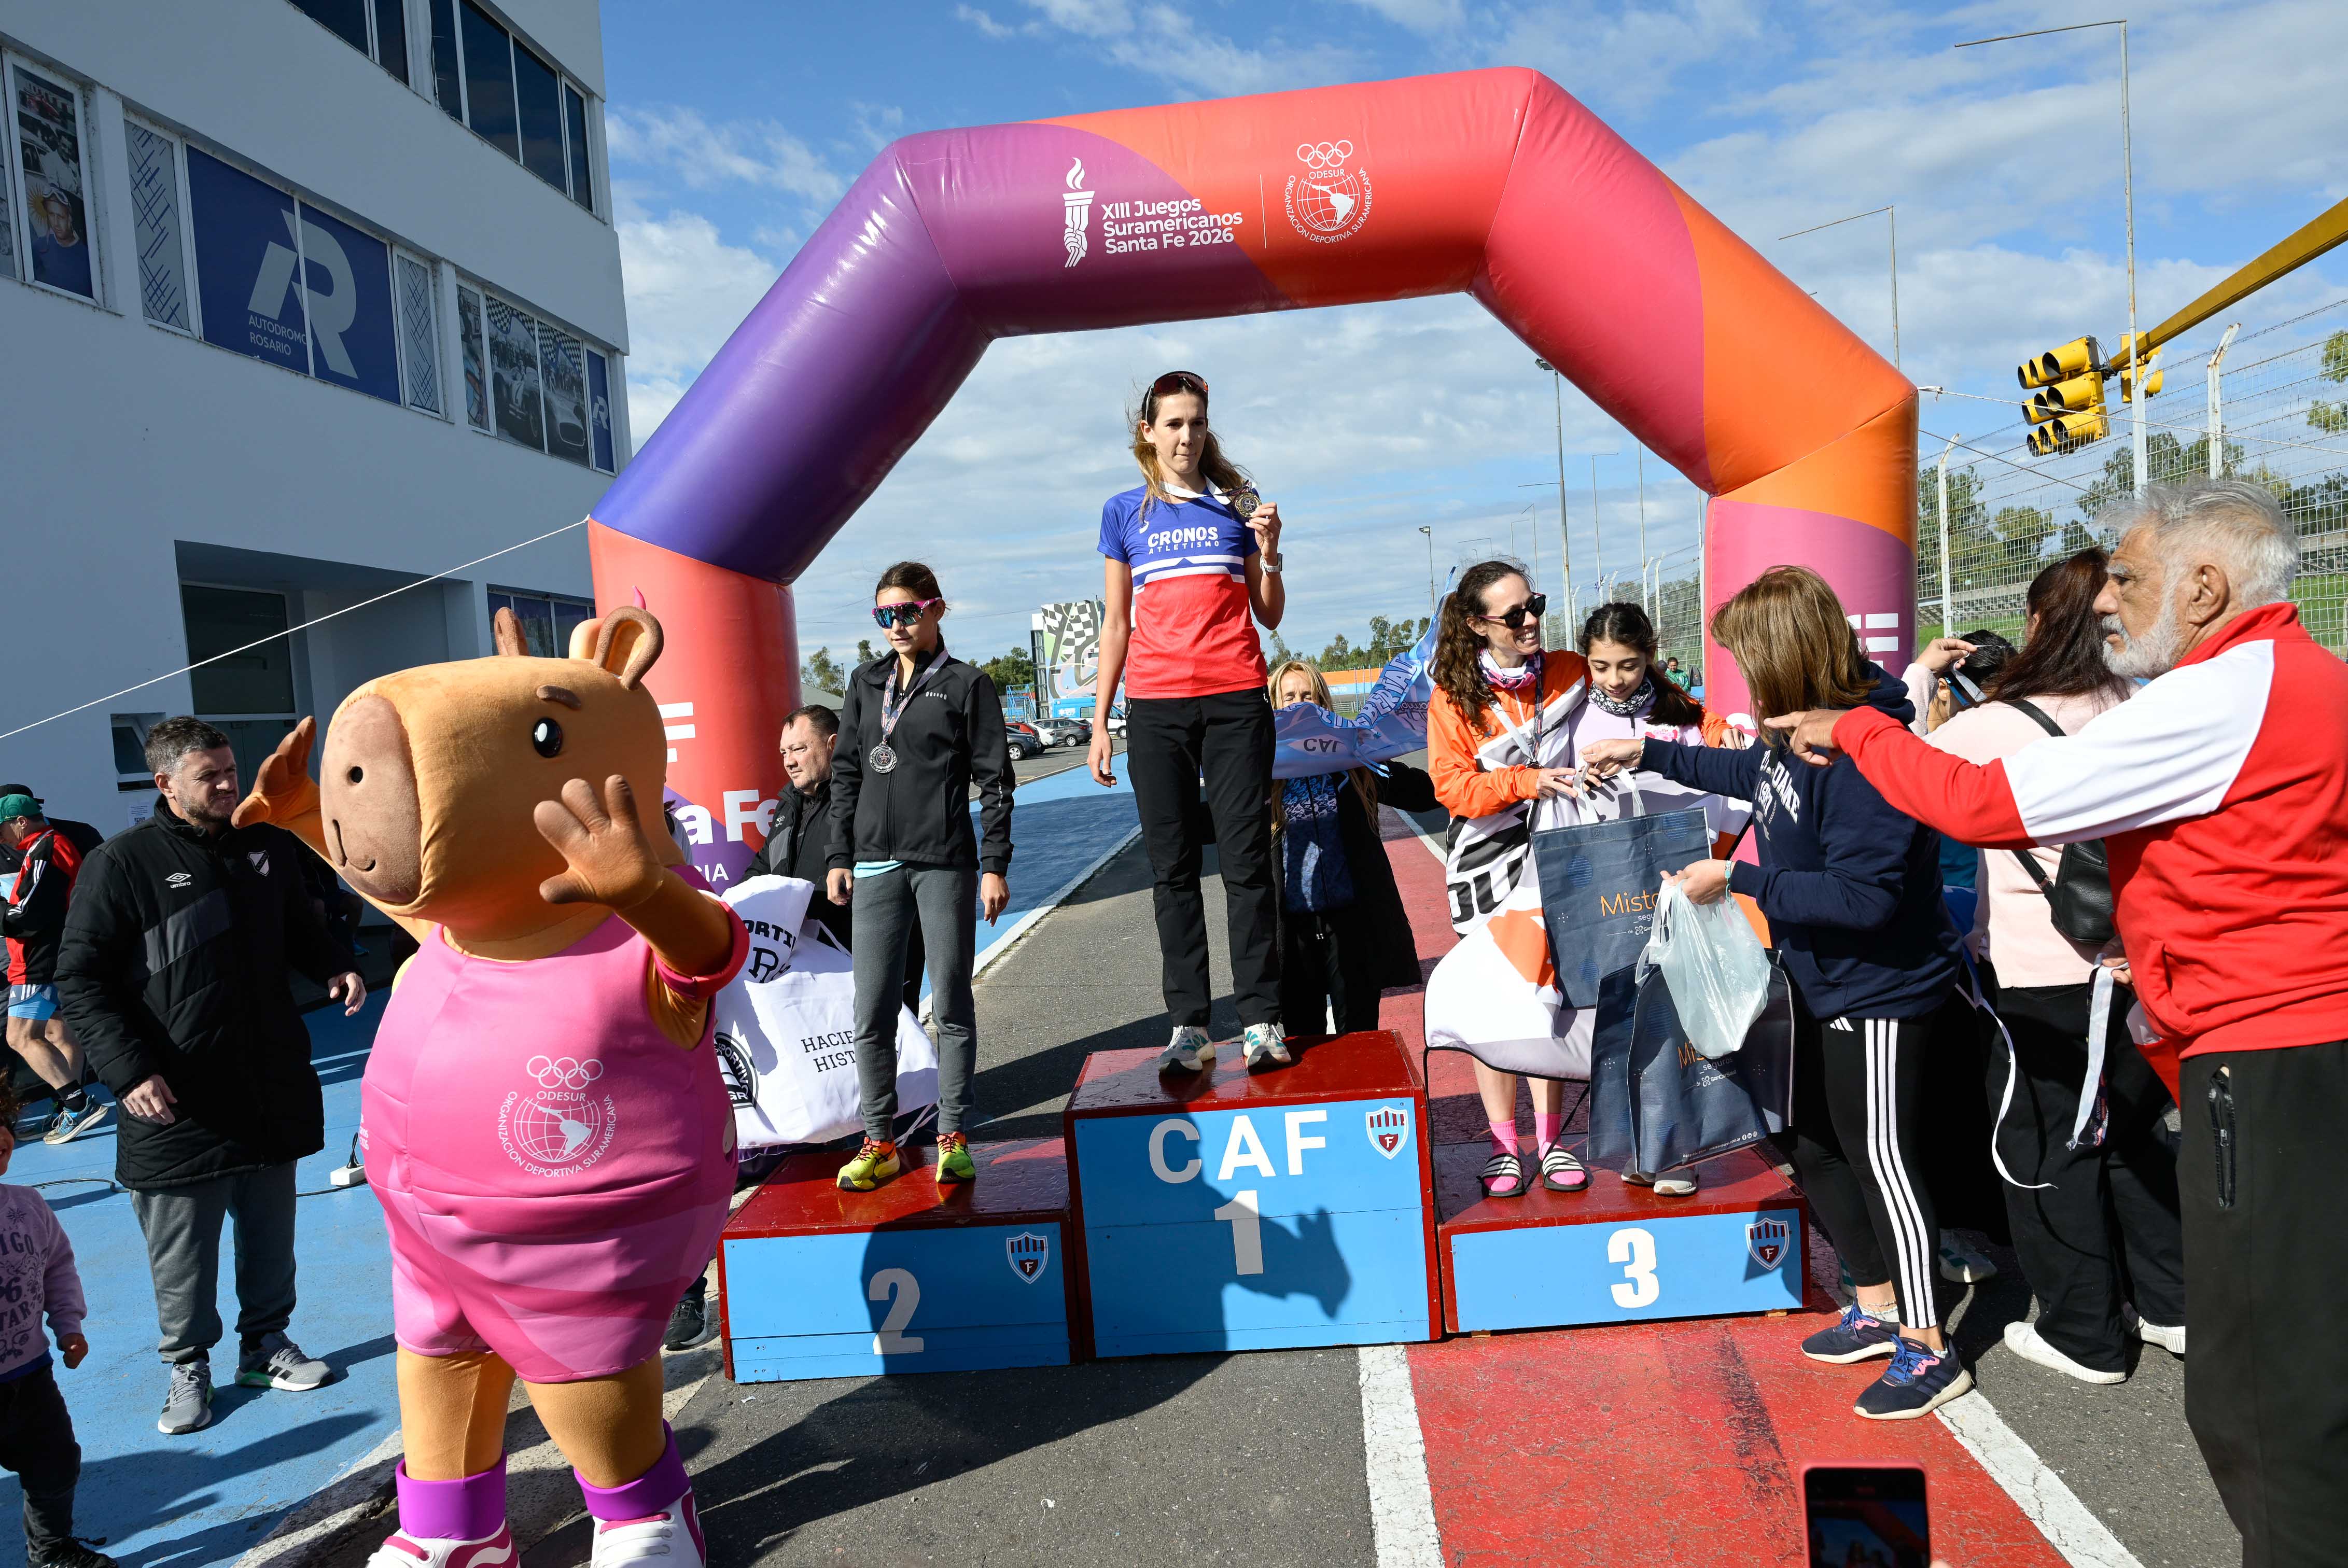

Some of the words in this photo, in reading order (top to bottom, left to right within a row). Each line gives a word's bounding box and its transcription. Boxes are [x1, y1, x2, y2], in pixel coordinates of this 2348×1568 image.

[1308, 169, 1345, 179] ODESUR
[1101, 202, 1131, 220] XIII
[1134, 198, 1201, 217] Juegos
[1284, 175, 1310, 237] ORGANIZACION
[1309, 230, 1353, 244] DEPORTIVA
[1351, 167, 1373, 232] SURAMERICANA
[1103, 212, 1243, 237] Suramericanos
[1105, 236, 1158, 254] Santa
[1162, 233, 1185, 249] Fe
[1188, 227, 1234, 246] 2026
[249, 331, 291, 355] ROSARIO
[1148, 526, 1219, 548] CRONOS
[1148, 540, 1219, 555] ATLETISMO
[801, 1030, 856, 1053] HACIE
[536, 1090, 586, 1101] ODESUR
[497, 1091, 526, 1167] ORGANIZACION
[524, 1163, 583, 1178] DEPORTIVA
[583, 1094, 617, 1168] SURAMERICANA
[1149, 1110, 1327, 1184] CAF
[1214, 1190, 1264, 1276] 1
[1607, 1227, 1660, 1308] 3
[869, 1268, 924, 1355] 2
